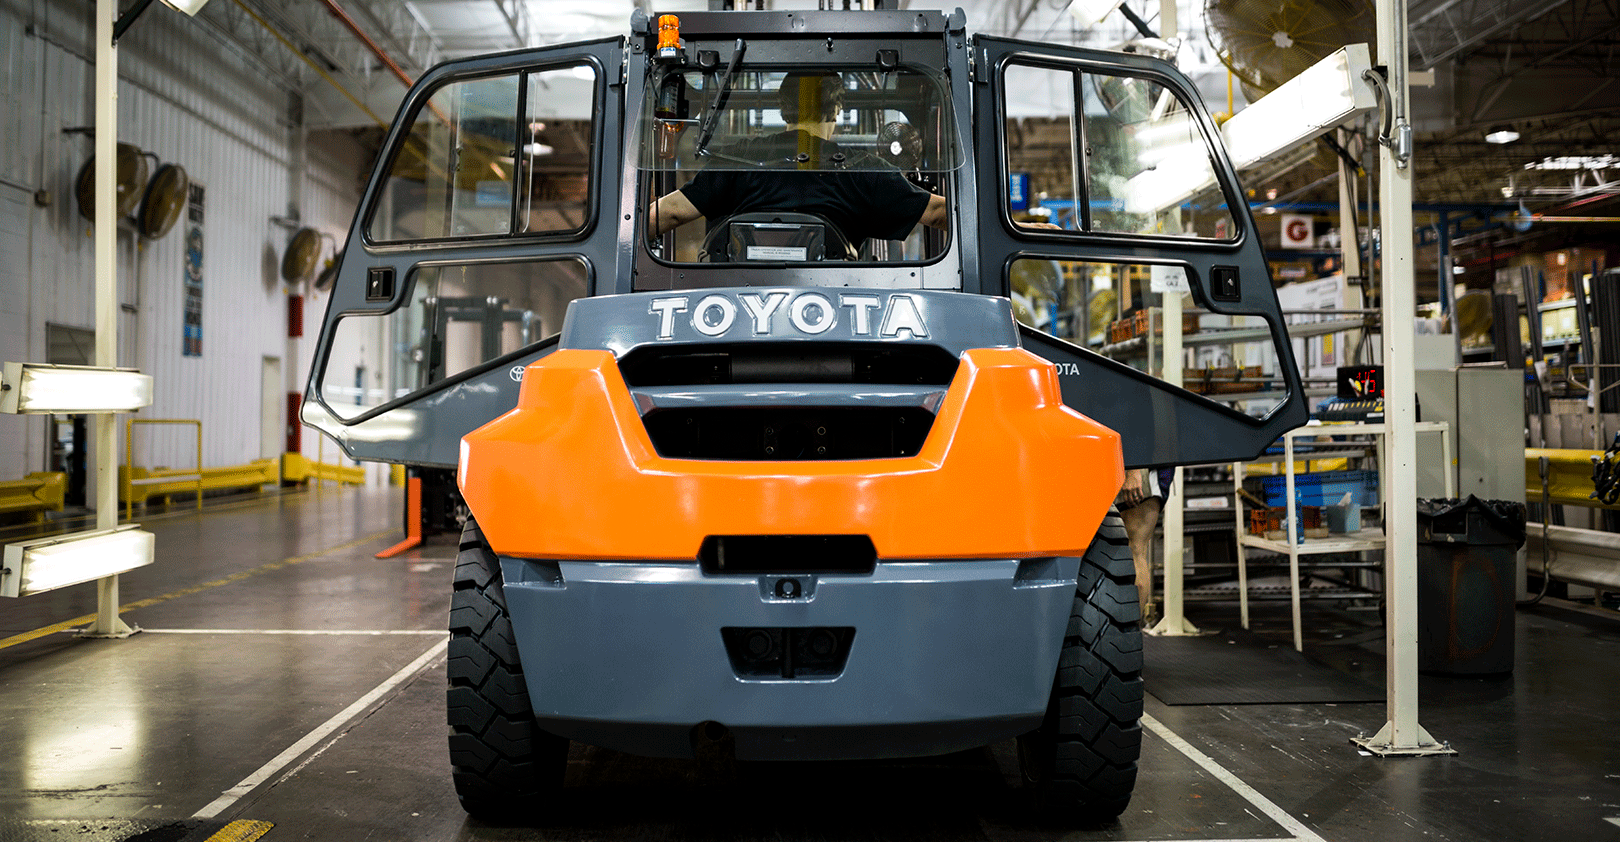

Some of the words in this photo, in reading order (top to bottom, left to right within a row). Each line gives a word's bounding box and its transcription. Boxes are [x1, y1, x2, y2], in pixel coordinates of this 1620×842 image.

[1286, 220, 1308, 241] G
[650, 292, 930, 340] TOYOTA
[1055, 362, 1080, 376] OTA
